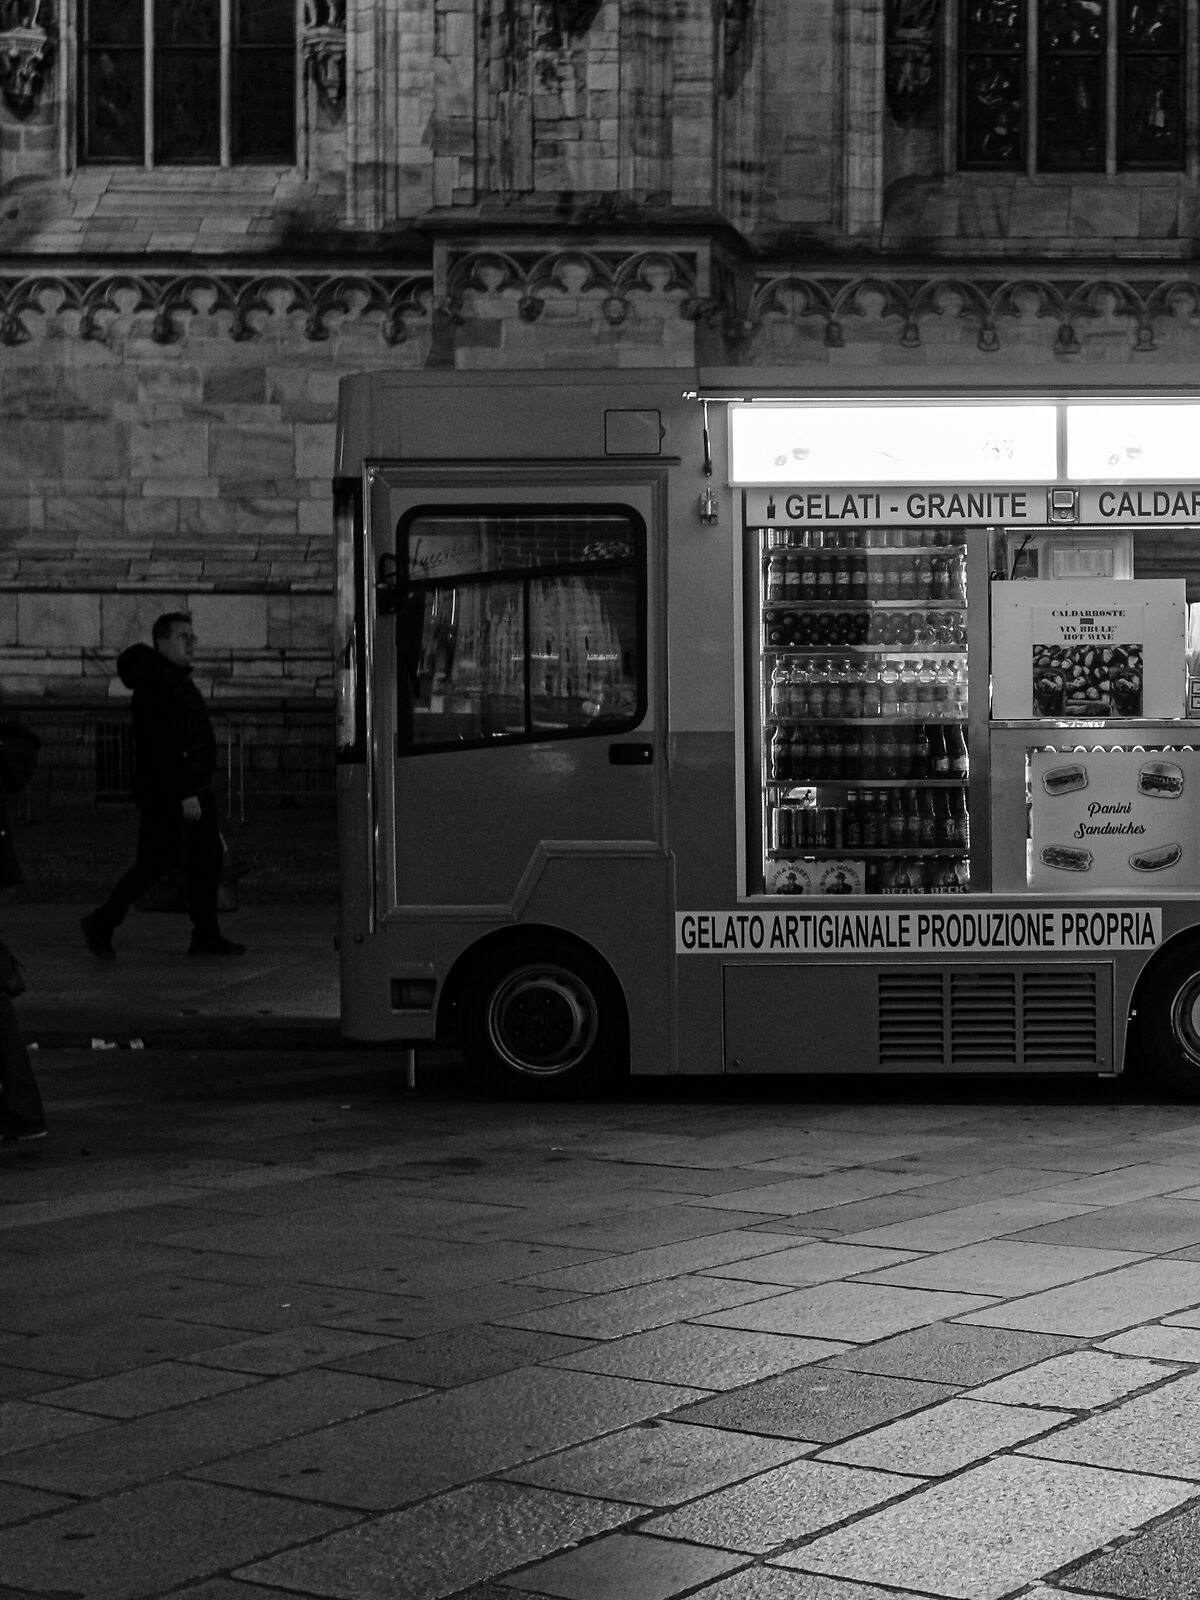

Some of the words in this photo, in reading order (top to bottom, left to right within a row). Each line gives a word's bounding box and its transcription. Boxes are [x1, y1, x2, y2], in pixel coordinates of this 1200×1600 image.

[785, 493, 881, 520] GELATI
[906, 492, 1028, 519] GRANITE
[1051, 609, 1126, 617] CALDARROSTE
[1060, 625, 1077, 633] VIN
[1087, 801, 1133, 818] Panini
[1073, 821, 1147, 839] Sandwiches
[681, 914, 765, 949] GELATO
[769, 914, 911, 949] ARTIGIANALE
[917, 912, 1055, 948] PRODUZIONE
[1061, 911, 1157, 946] PROPRIA
